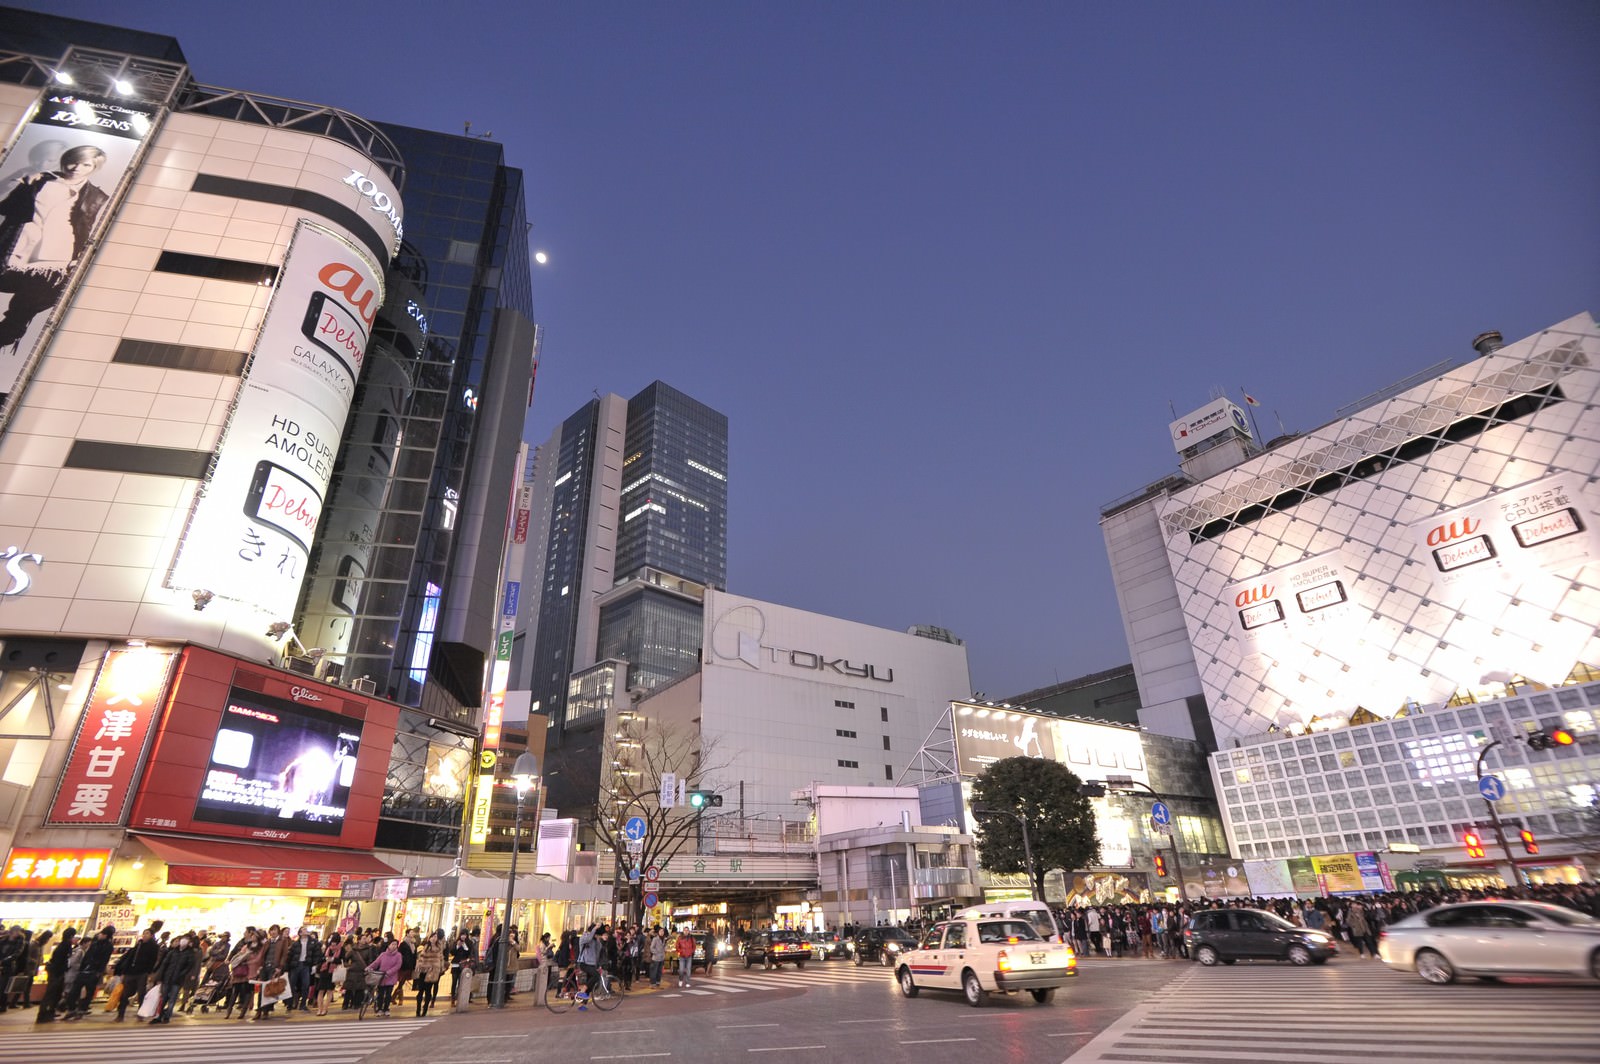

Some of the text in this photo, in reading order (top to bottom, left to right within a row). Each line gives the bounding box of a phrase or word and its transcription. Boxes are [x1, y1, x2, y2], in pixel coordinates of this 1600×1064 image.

[318, 262, 377, 337] au
[293, 345, 341, 382] GALAXY
[272, 414, 300, 437] HD
[1500, 485, 1564, 512] デュアルコア
[1505, 494, 1572, 522] CPU搭載
[1427, 516, 1481, 547] au
[0, 546, 43, 596] 'S
[1235, 584, 1275, 608] au
[500, 636, 510, 656] レイク
[760, 645, 894, 683] TOKYU
[655, 857, 743, 873] 渋谷駅
